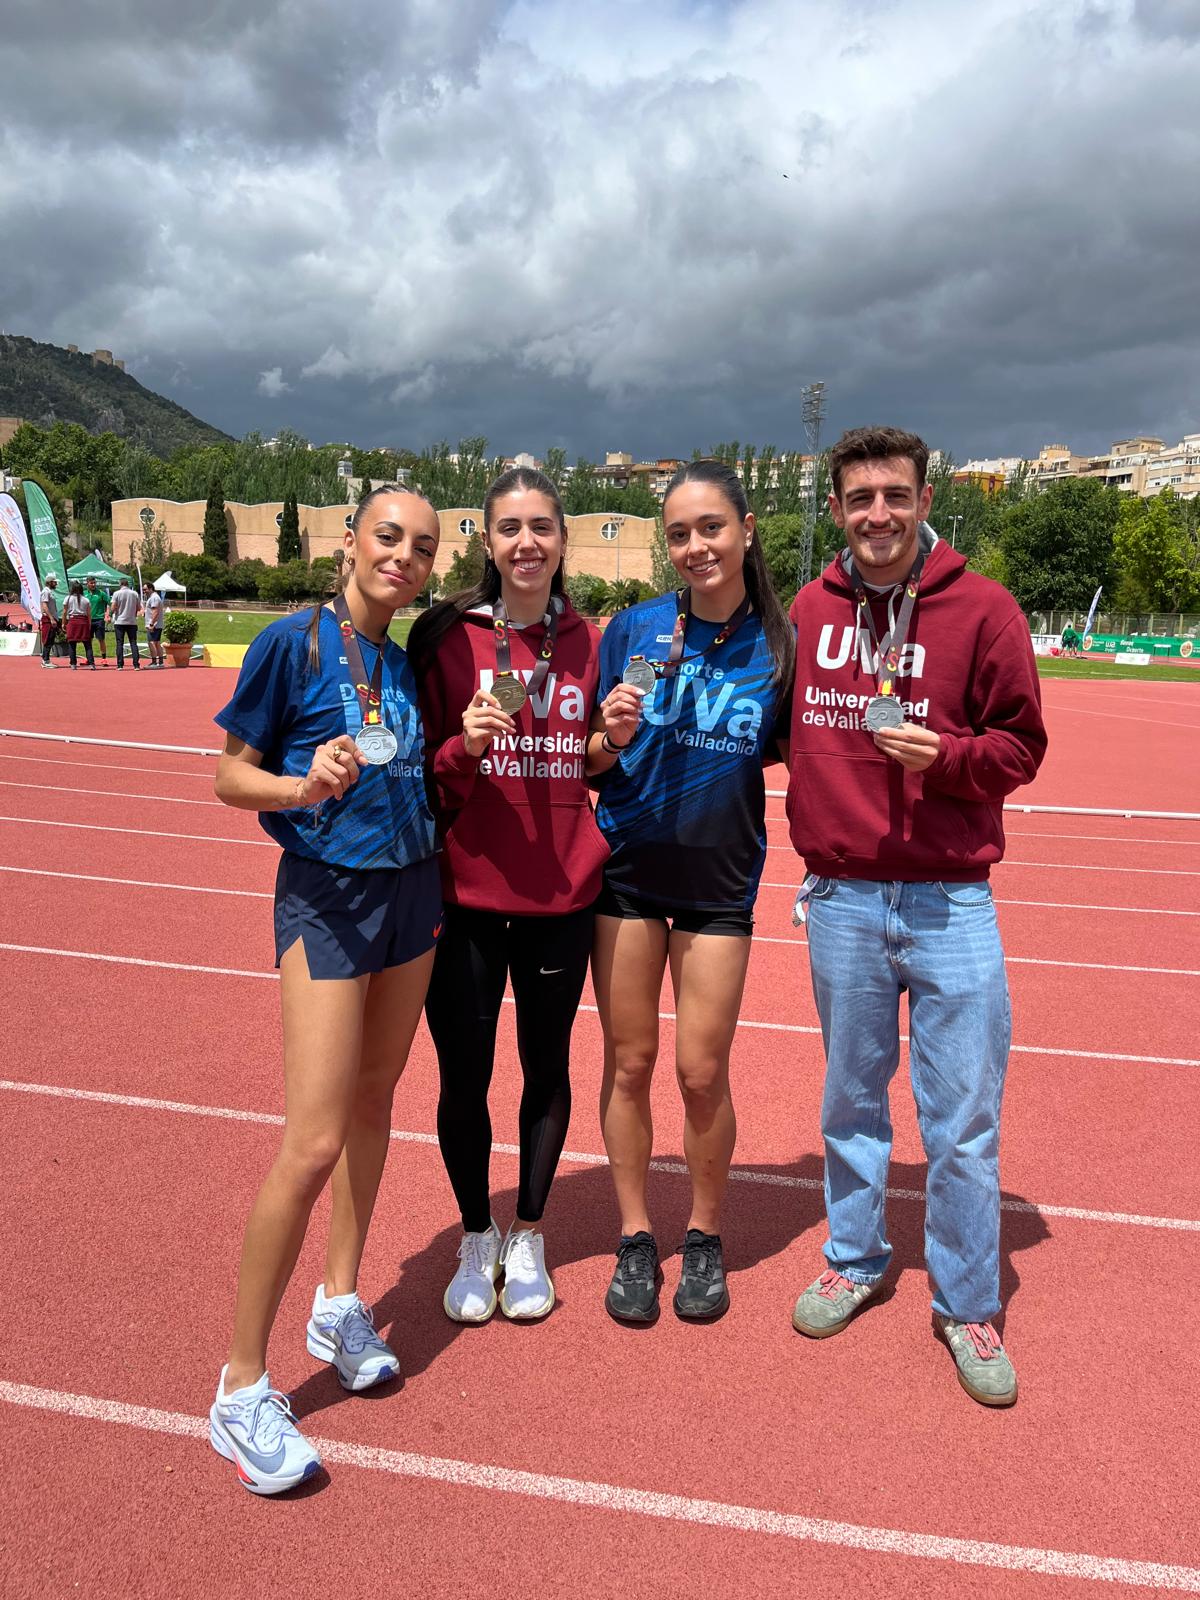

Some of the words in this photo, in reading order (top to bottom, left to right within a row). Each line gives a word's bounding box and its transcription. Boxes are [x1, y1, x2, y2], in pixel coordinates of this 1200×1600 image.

[816, 623, 927, 679] UVa
[642, 675, 763, 741] UVa
[805, 685, 930, 718] Univerad
[492, 729, 587, 755] niversidad
[674, 728, 758, 756] Valladolid
[478, 754, 586, 780] eValladoli
